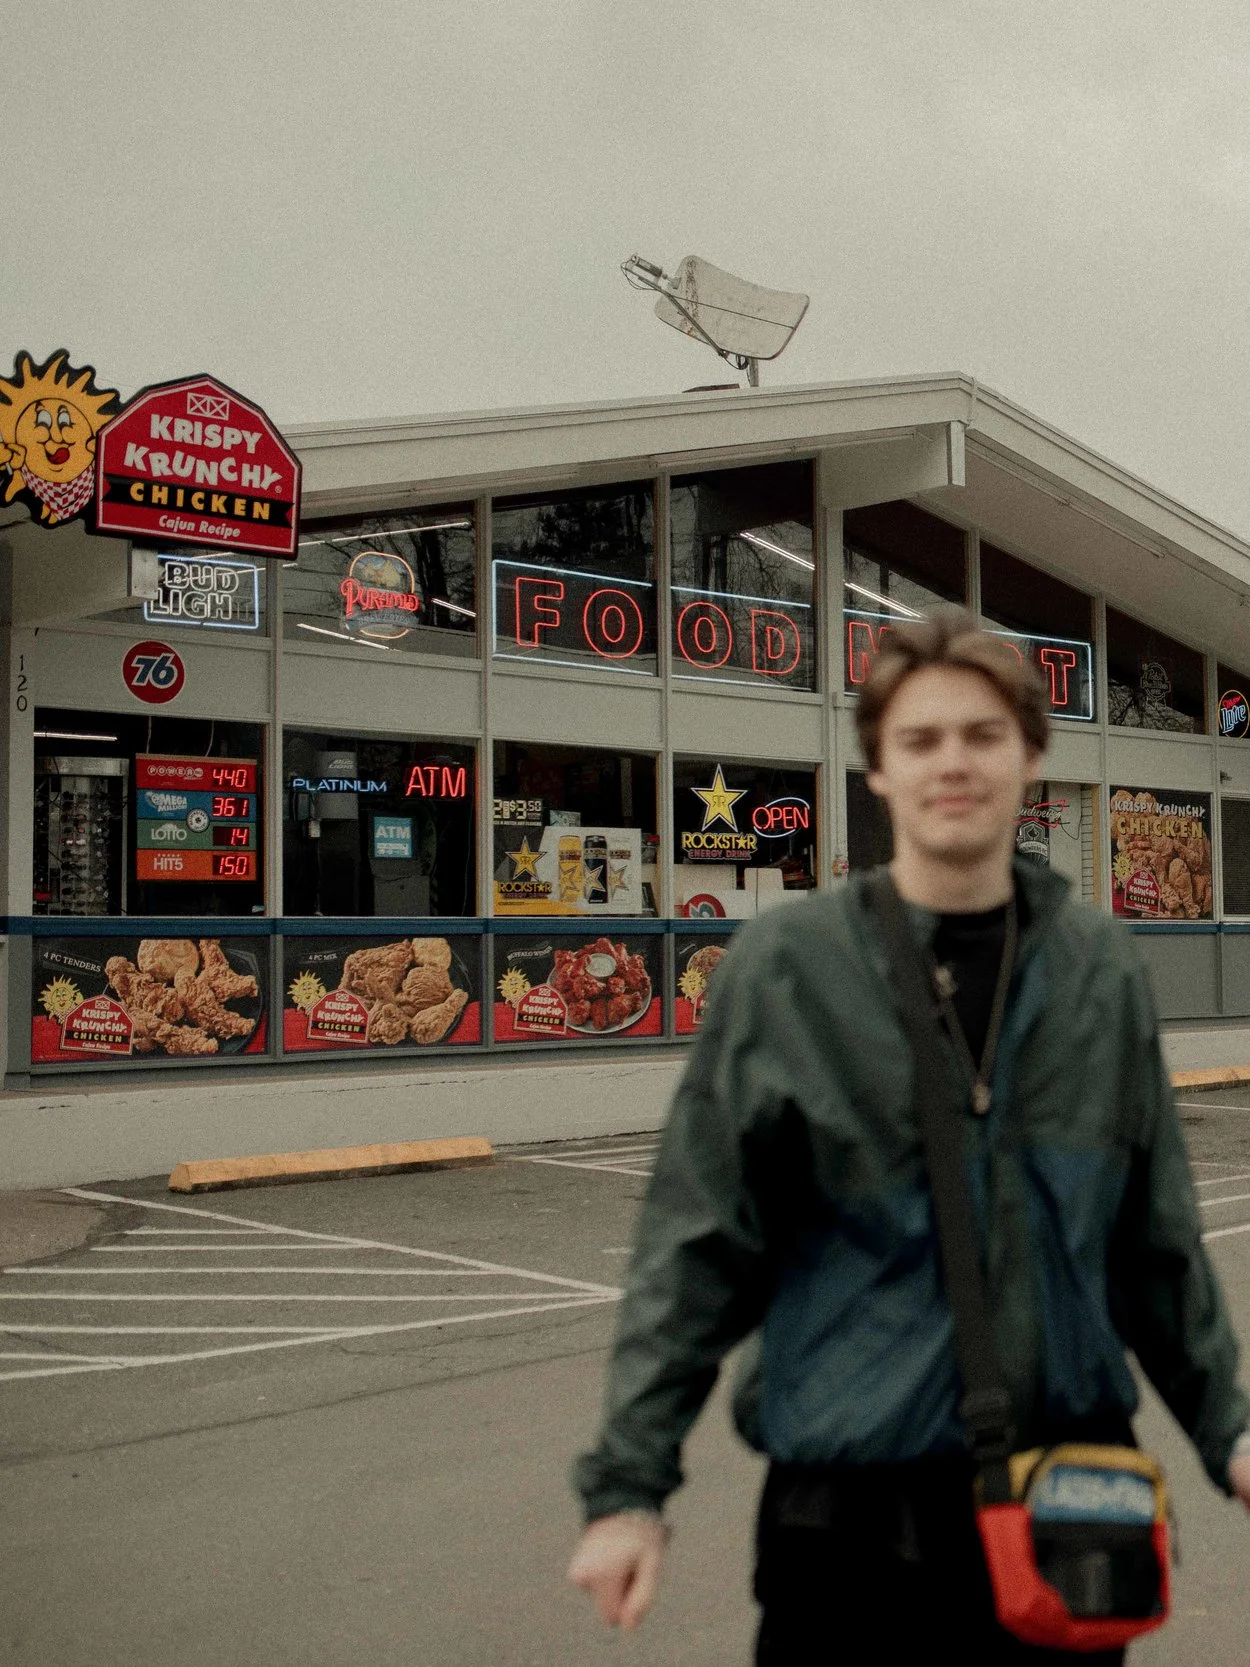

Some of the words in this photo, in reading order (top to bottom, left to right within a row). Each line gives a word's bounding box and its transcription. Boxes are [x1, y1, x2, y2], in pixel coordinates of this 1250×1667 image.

[150, 414, 262, 453] KRISPY
[124, 442, 283, 491] KRUNCHY
[130, 482, 270, 520] CHICKEN
[159, 514, 196, 534] Cajun
[199, 520, 241, 538] Recipe
[165, 562, 238, 593] BUD
[515, 577, 801, 674] FOOD
[848, 621, 1076, 706] MT
[131, 653, 176, 689] 76
[1221, 705, 1247, 734] Lite
[213, 769, 247, 788] 440
[292, 778, 387, 793] PLATINUM
[405, 766, 466, 798] ATM
[213, 797, 248, 817] 361
[1115, 800, 1154, 813] KRISPY
[1155, 803, 1206, 818] KRUNCHY
[752, 807, 809, 830] OPEN
[150, 828, 188, 841] LOTTO
[375, 825, 410, 839] ATM
[1117, 817, 1203, 839] CHICKEN
[688, 850, 722, 859] ENERGY
[726, 850, 751, 860] DRINK
[219, 856, 248, 876] 150
[1133, 878, 1154, 888] KRISPY
[1129, 895, 1156, 905] CHICKEN
[43, 951, 49, 959] 4
[49, 952, 62, 963] PC
[62, 957, 101, 973] TENDERS
[324, 1000, 359, 1012] KRISPY
[528, 995, 560, 1006] KRISPY
[81, 1008, 122, 1021] KRISPY
[316, 1010, 365, 1023] KRUNCHY
[521, 1004, 563, 1016] KRUNCHY
[522, 1014, 560, 1024] CHICKEN
[72, 1019, 127, 1033] KRUNCHY
[317, 1022, 361, 1032] CHICKEN
[73, 1031, 122, 1043] CHICKEN
